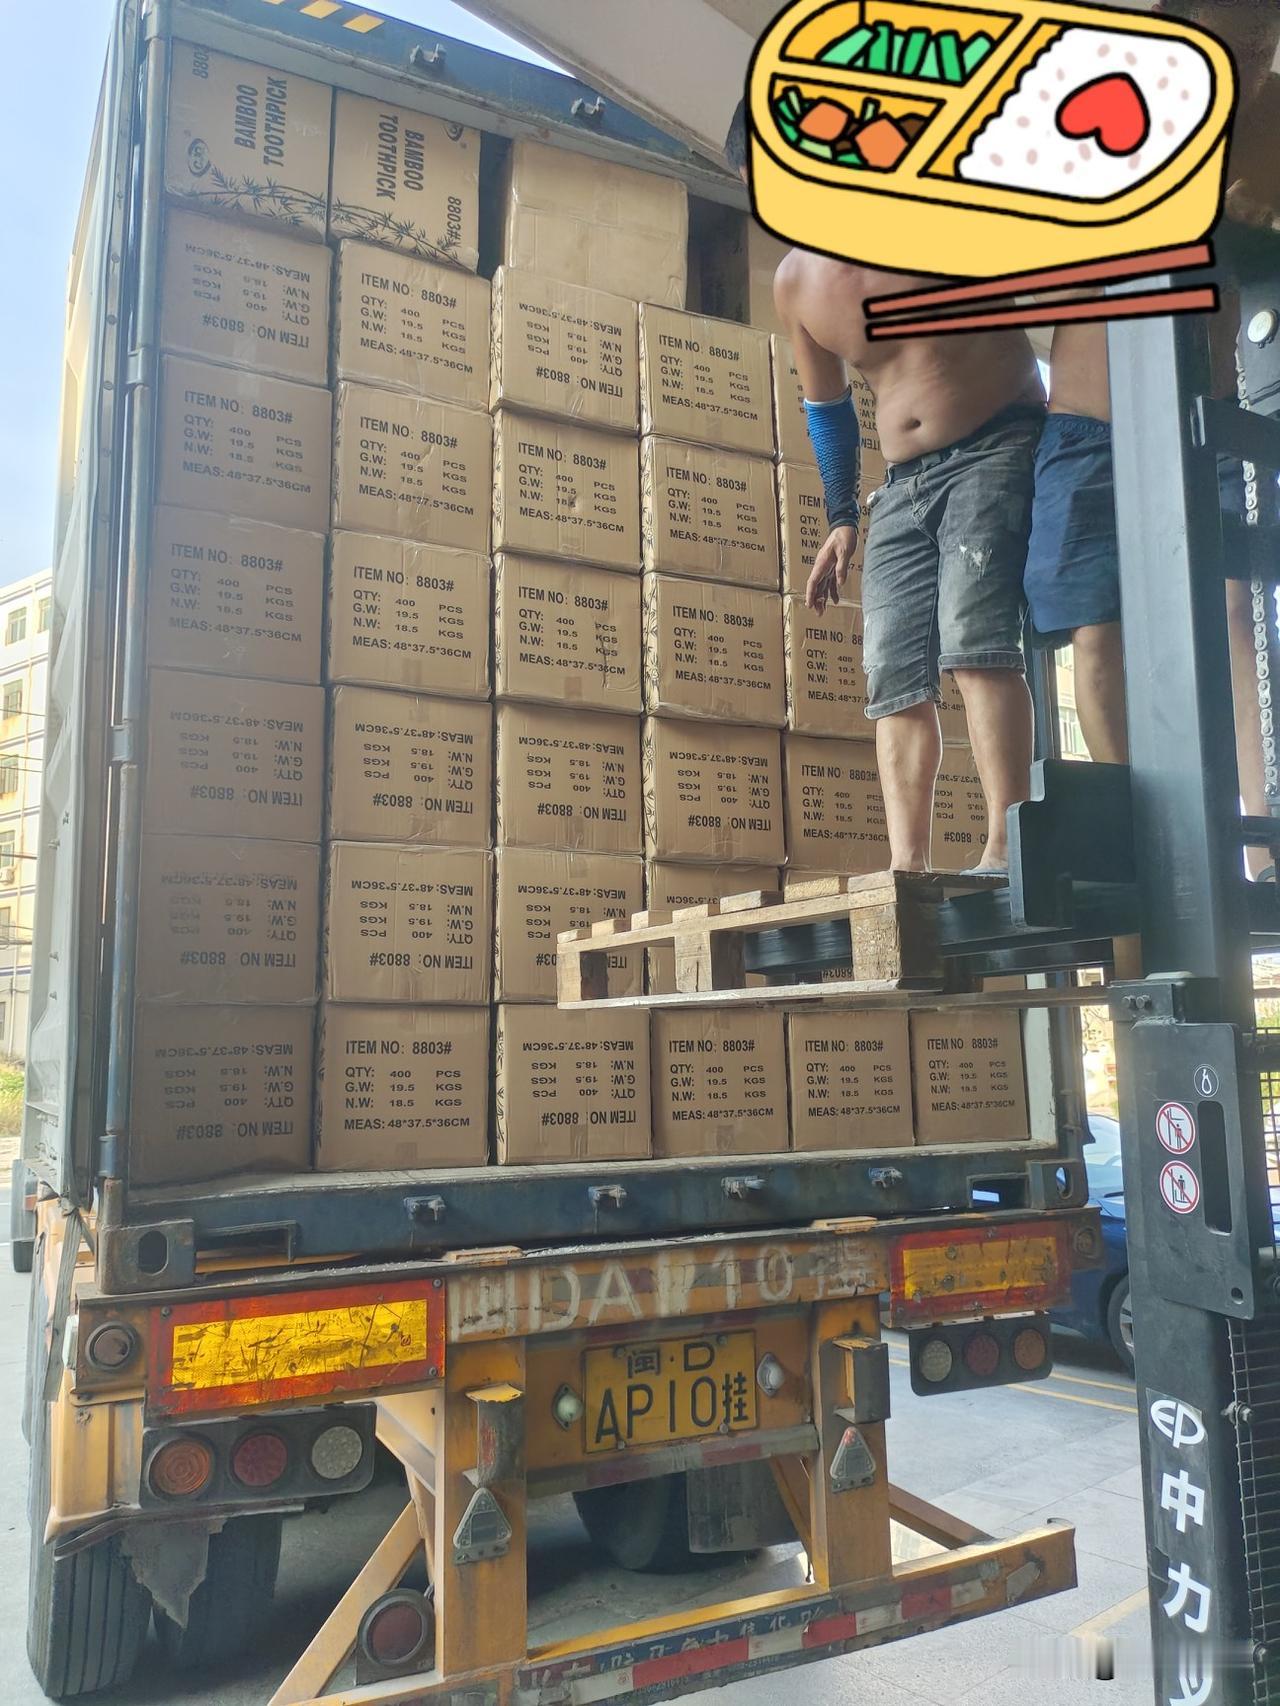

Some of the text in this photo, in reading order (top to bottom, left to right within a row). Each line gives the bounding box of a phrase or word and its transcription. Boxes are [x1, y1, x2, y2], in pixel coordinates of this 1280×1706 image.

[234, 84, 258, 150] BAMBOO
[263, 76, 287, 168] TOOTHPICK
[376, 114, 398, 201] TOOTHPICK
[403, 128, 424, 191] BAMBOO
[446, 196, 462, 240] 8803#
[361, 272, 456, 309] ITEM NO: 8803#
[202, 312, 245, 334] 8803#
[279, 329, 309, 348] ITEM
[659, 334, 682, 349] ITEM
[709, 345, 739, 362] 8803#
[660, 354, 748, 381] QTY: 400 PCS
[536, 365, 623, 398] ITEM NO: 8803#
[185, 390, 216, 409] ITEM
[252, 404, 292, 424] 8803#
[360, 416, 457, 449] ITEM NO: 8803#
[518, 442, 606, 470] ITEM NO: 8803#
[666, 466, 747, 492] ITEM NO: 8803#
[798, 494, 820, 508] ITEM
[171, 543, 203, 561] ITEM
[241, 553, 282, 572] 8803#
[354, 566, 453, 592] ITEM NO: 8803#
[353, 589, 462, 614] QTY: 400 PCS
[518, 586, 608, 611] ITEM NO: 8803#
[353, 602, 464, 626] G.W: 19.5 KGS
[673, 605, 754, 628] ITEM NO: 8803#
[353, 616, 463, 639] N.W: 18.5 KGS
[806, 628, 828, 640] ITEM
[806, 648, 828, 659] QTY:
[527, 754, 625, 773] N.W: 18.5 KGS
[801, 764, 825, 777] ITEM
[526, 768, 626, 786] G.W: 19.5 KGS
[190, 784, 234, 802] 8803#
[271, 790, 303, 806] ITEM
[528, 781, 626, 798] QTY: 400 PCS
[802, 786, 824, 796] QTY:
[373, 793, 473, 813] ITEM NO: 8803#
[537, 802, 627, 820] ITEM NO: 8803#
[802, 798, 824, 808] G.W:
[688, 815, 722, 828] 8803#
[748, 817, 772, 830] ITEM
[944, 832, 972, 843] 8803#
[526, 904, 551, 912] KGS
[570, 906, 591, 914] 18.5
[180, 950, 226, 966] 8803#
[264, 952, 296, 967] ITEM
[370, 952, 473, 968] ITEM NO: 8803#
[346, 1041, 451, 1054] ITEM NO: 8803#
[669, 1039, 755, 1053] ITEM NO: 8803#
[805, 1040, 883, 1052] ITEM NO: 8803#
[927, 1038, 948, 1050] ITEM
[971, 1037, 998, 1049] 8803#
[345, 1067, 374, 1078] QTY:
[390, 1070, 411, 1078] 400
[670, 1064, 694, 1074] QTY:
[345, 1082, 374, 1093] G.W:
[670, 1077, 694, 1087] G.W:
[345, 1097, 373, 1108] N.W:
[671, 1091, 695, 1101] N.W:
[541, 1111, 579, 1127] 8803#
[610, 1109, 636, 1123] ITEM
[176, 1123, 223, 1142] 8803#
[262, 1119, 294, 1136] ITEM
